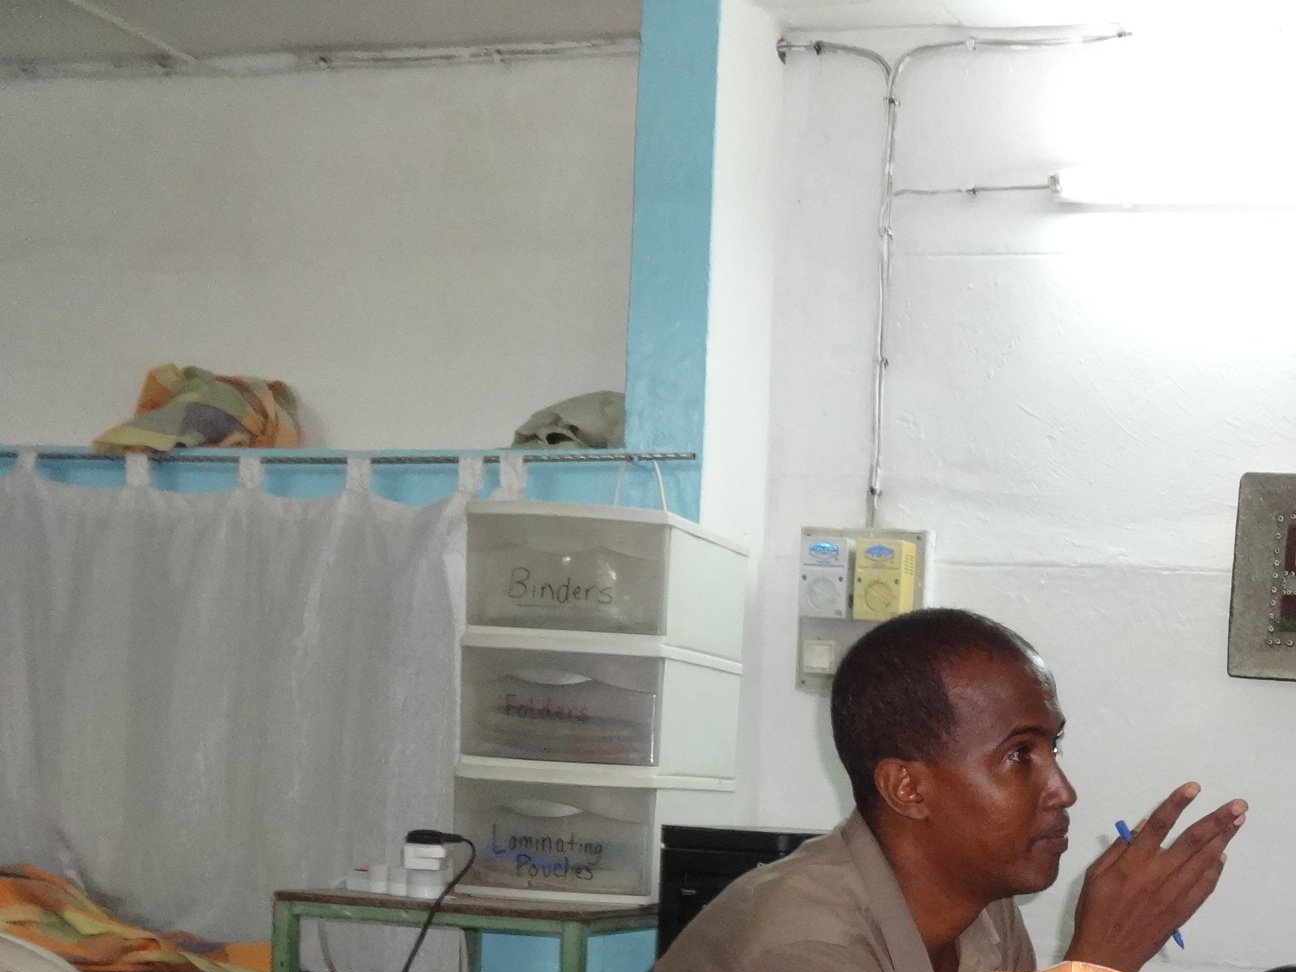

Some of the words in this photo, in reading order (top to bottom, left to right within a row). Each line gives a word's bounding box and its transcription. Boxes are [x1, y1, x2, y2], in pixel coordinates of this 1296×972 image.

[508, 566, 614, 605] Binders
[492, 823, 604, 866] Laminating
[515, 853, 594, 881] Pouches
